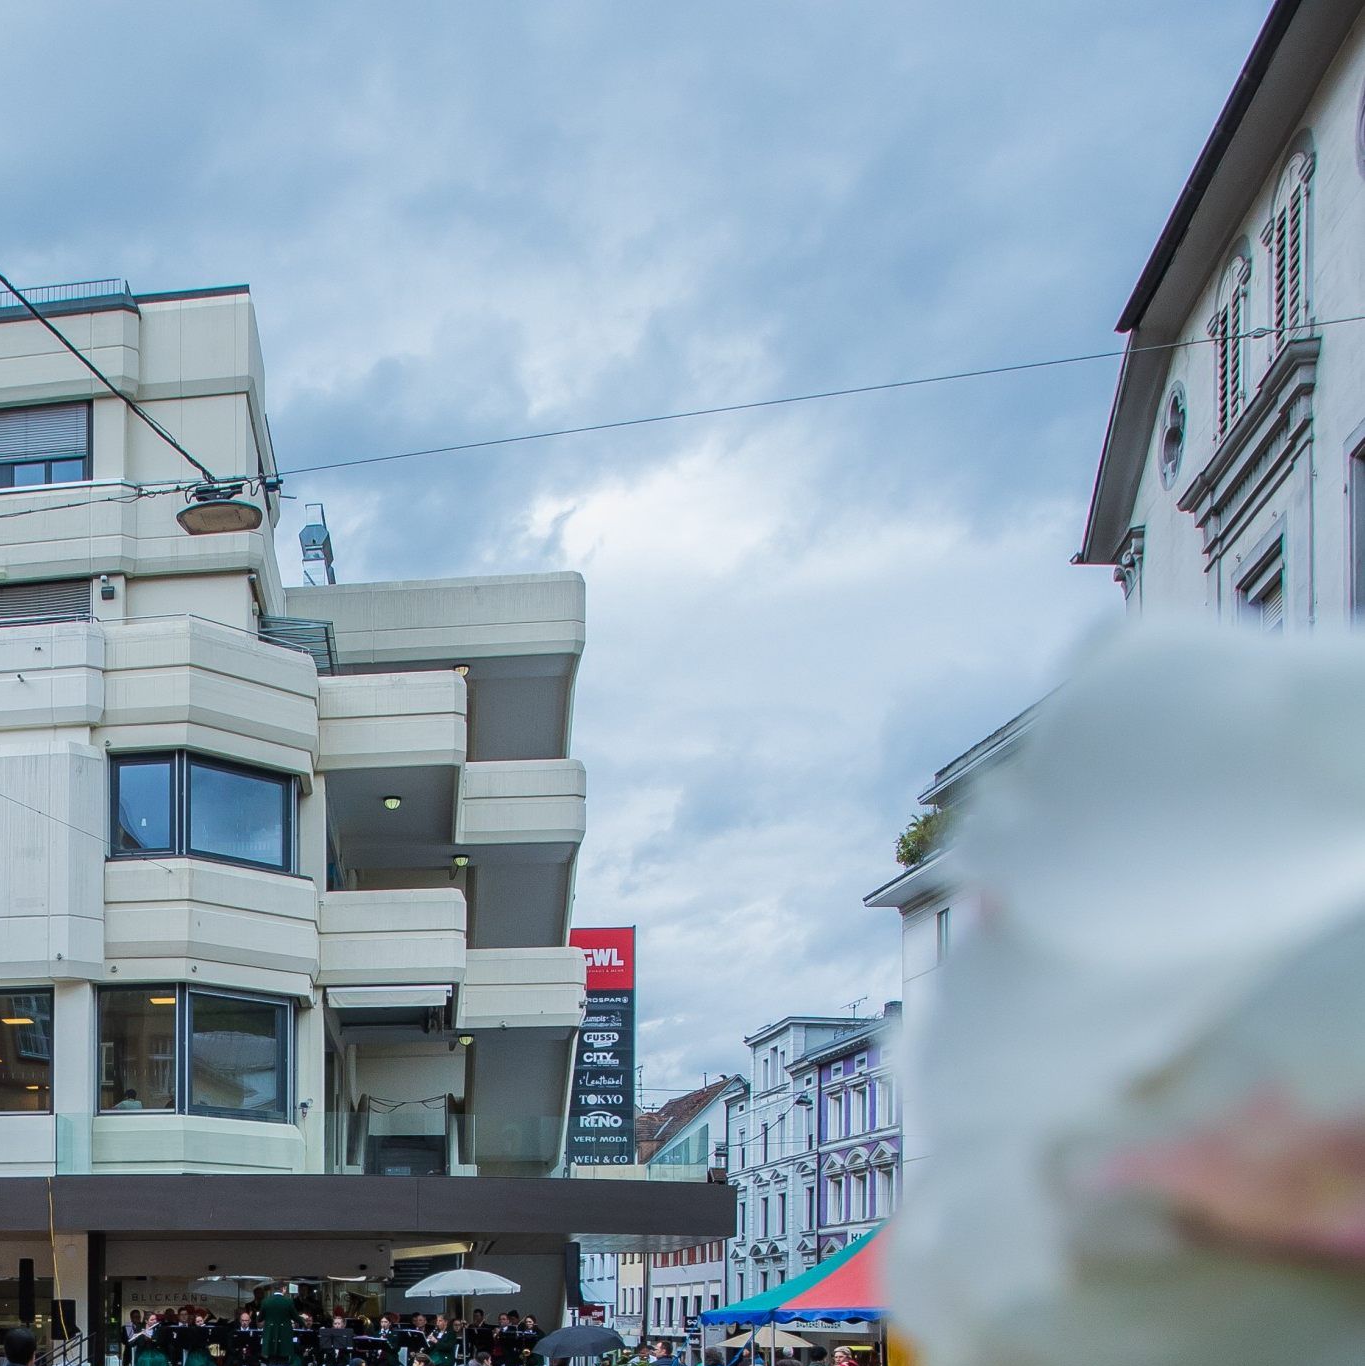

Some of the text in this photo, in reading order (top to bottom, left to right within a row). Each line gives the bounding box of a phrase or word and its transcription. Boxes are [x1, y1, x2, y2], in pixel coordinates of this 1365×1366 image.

[586, 1033, 617, 1041] FUSSL
[583, 1052, 614, 1063] CITY
[579, 1094, 623, 1105] TOKYO
[579, 1115, 623, 1128] RENO
[574, 1155, 628, 1163] WEIN & CO
[131, 1293, 208, 1301] BLICKFANG
